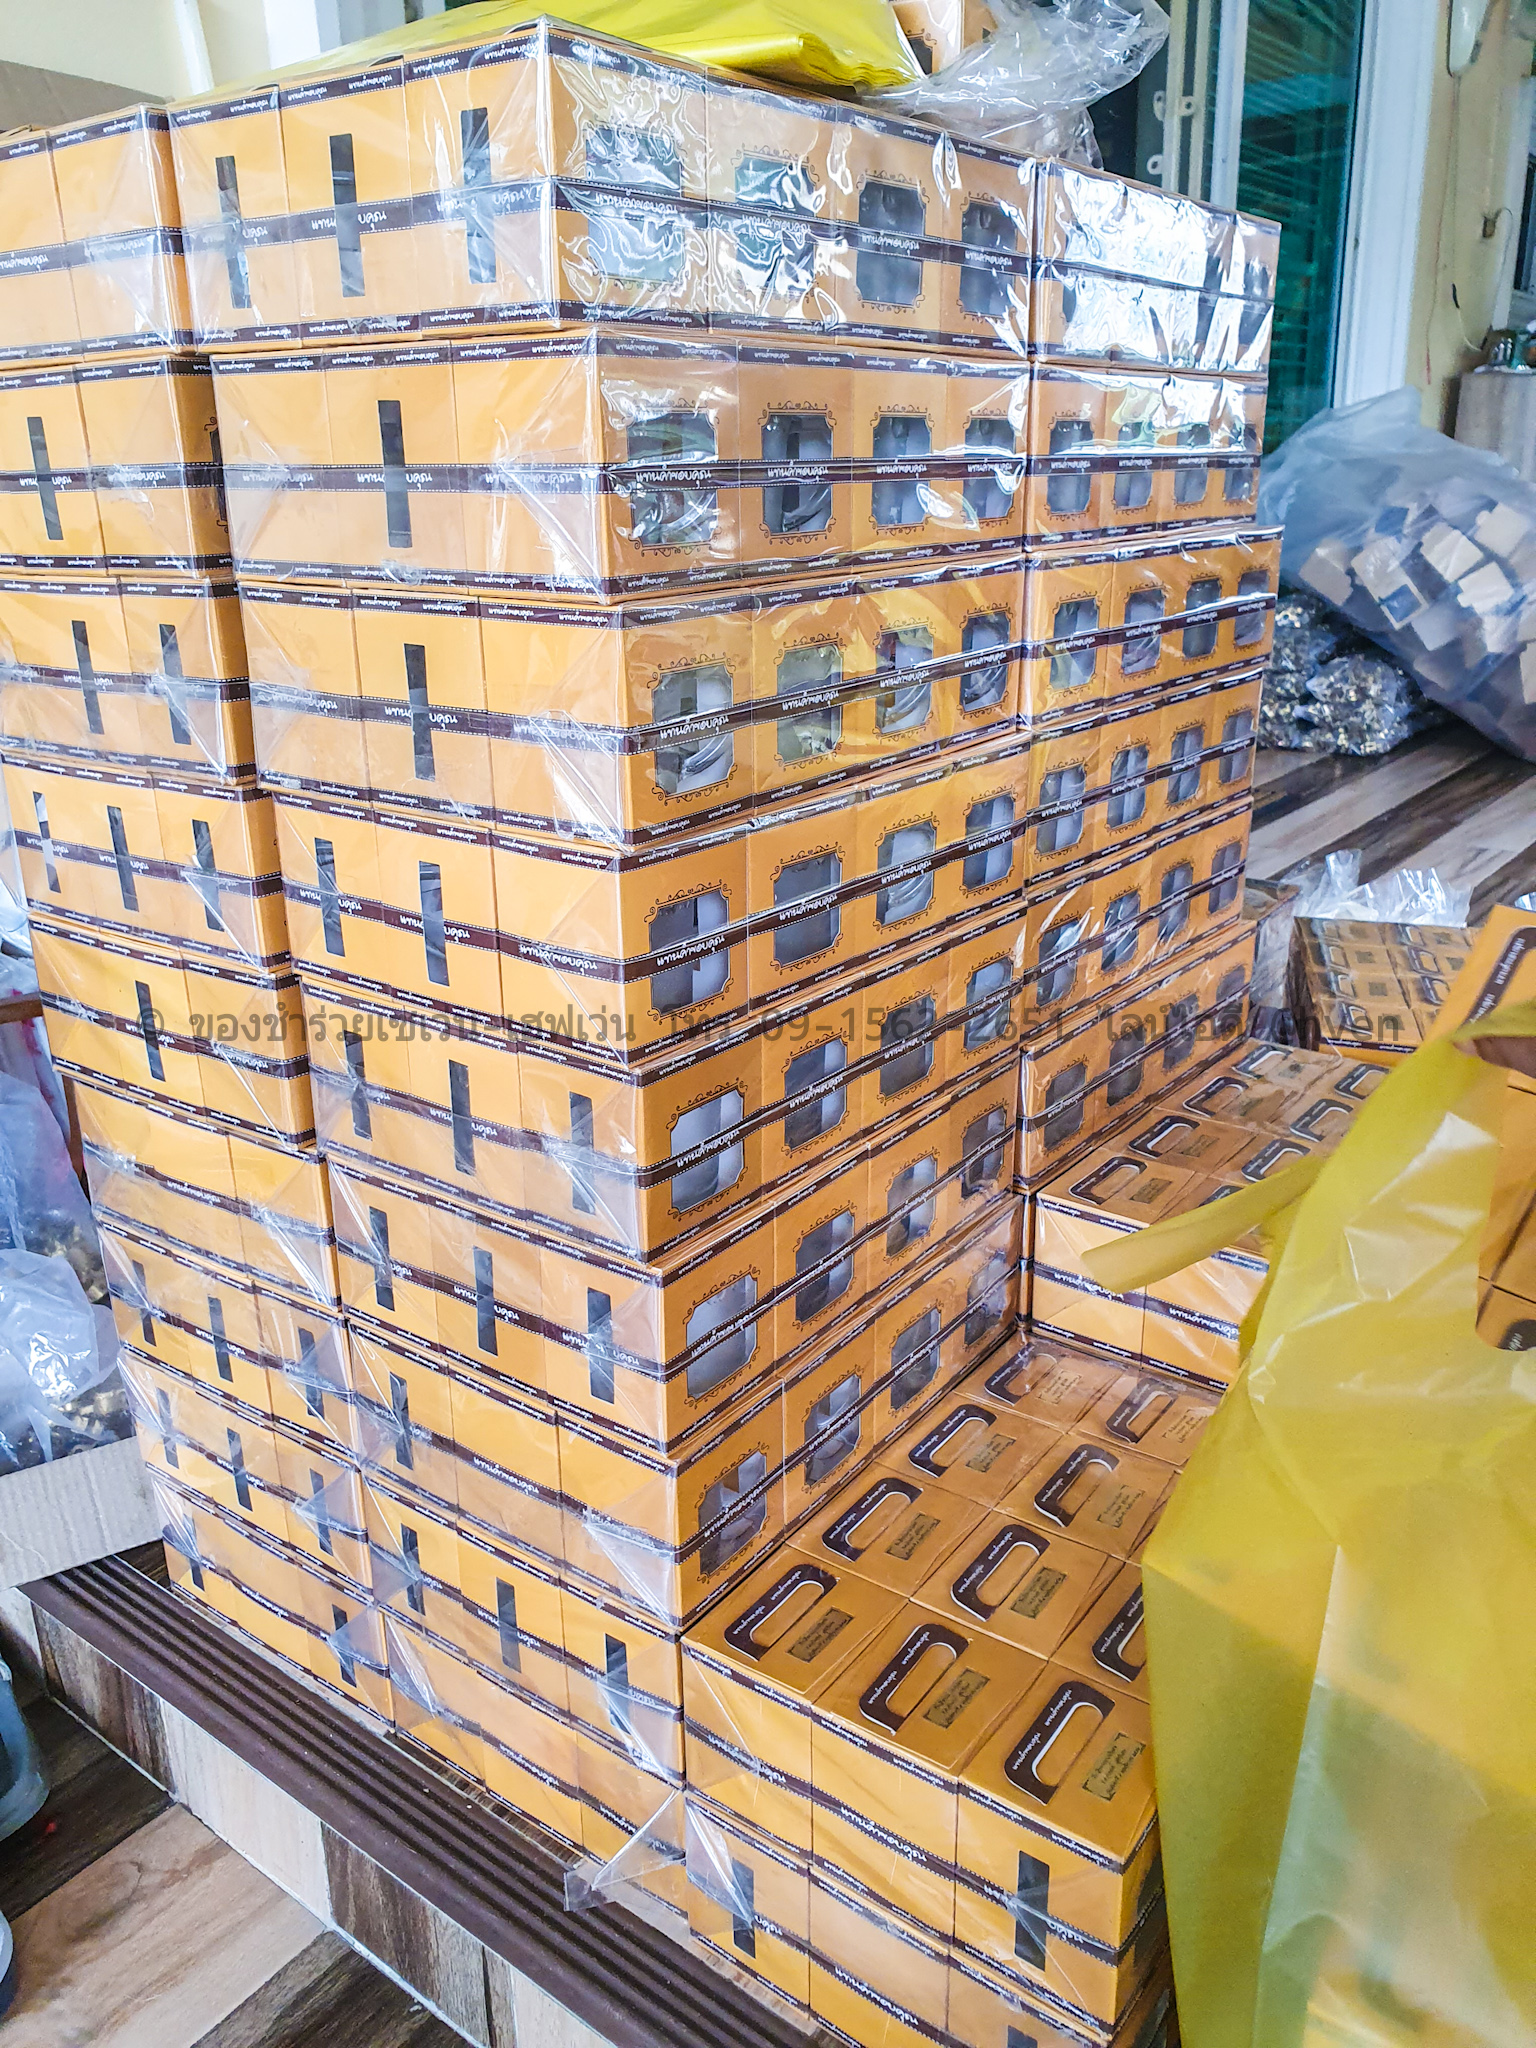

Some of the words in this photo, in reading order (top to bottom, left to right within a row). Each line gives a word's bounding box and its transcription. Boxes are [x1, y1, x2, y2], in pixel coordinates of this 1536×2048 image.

[841, 1806, 927, 1860] แทนคำขอบคุณ
[835, 1967, 918, 2025] แทนคำขอบคุณ
